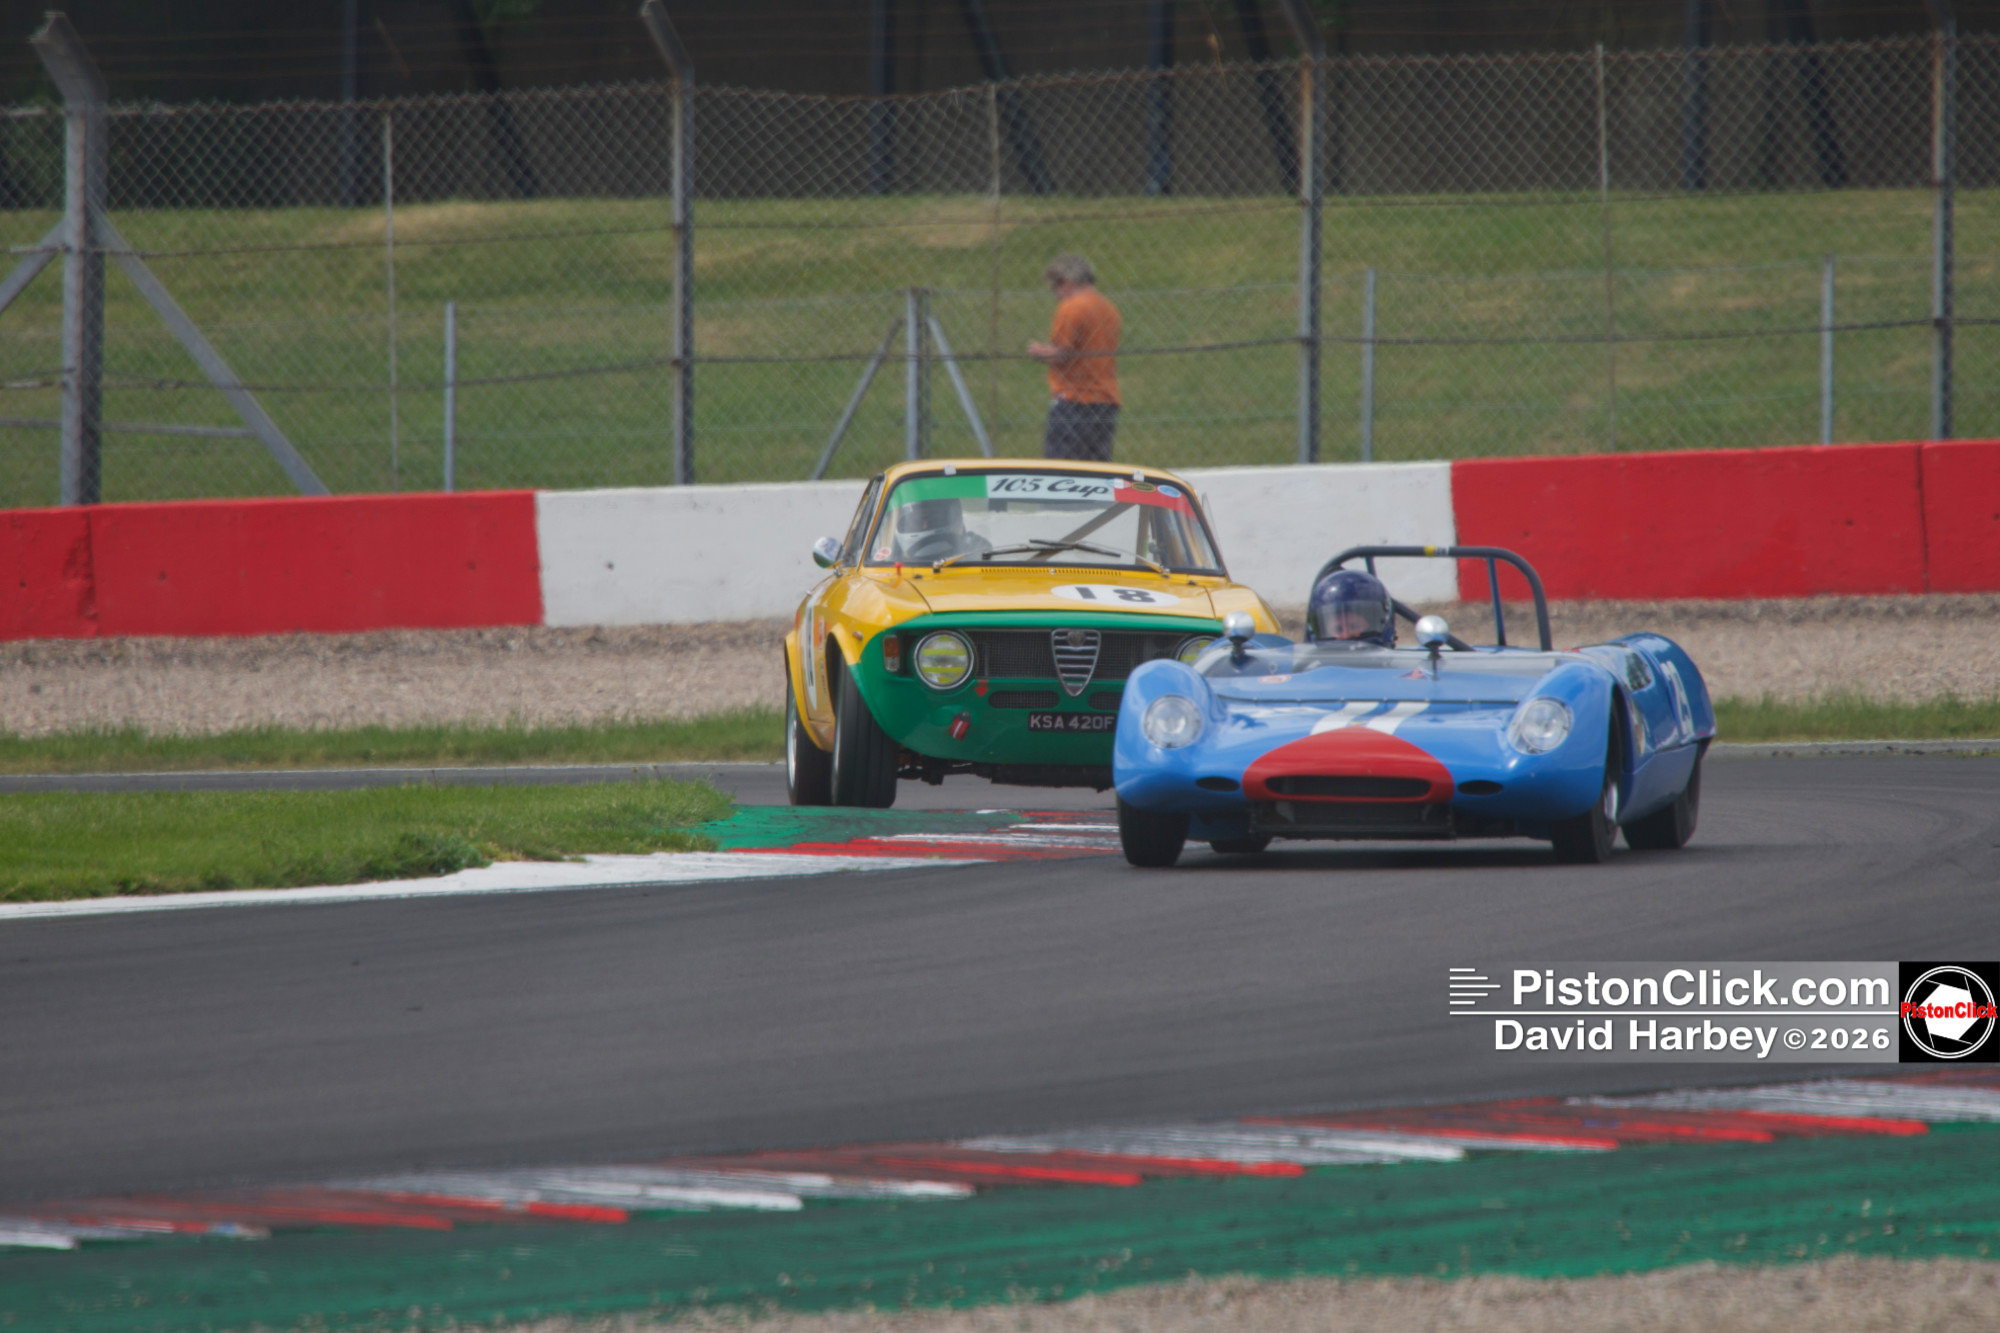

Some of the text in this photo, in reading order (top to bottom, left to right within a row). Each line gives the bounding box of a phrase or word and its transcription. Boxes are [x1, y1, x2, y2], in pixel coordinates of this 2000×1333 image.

[991, 477, 1109, 498] 105 Cup
[1074, 586, 1157, 603] 18
[1030, 714, 1115, 730] KSA 420F
